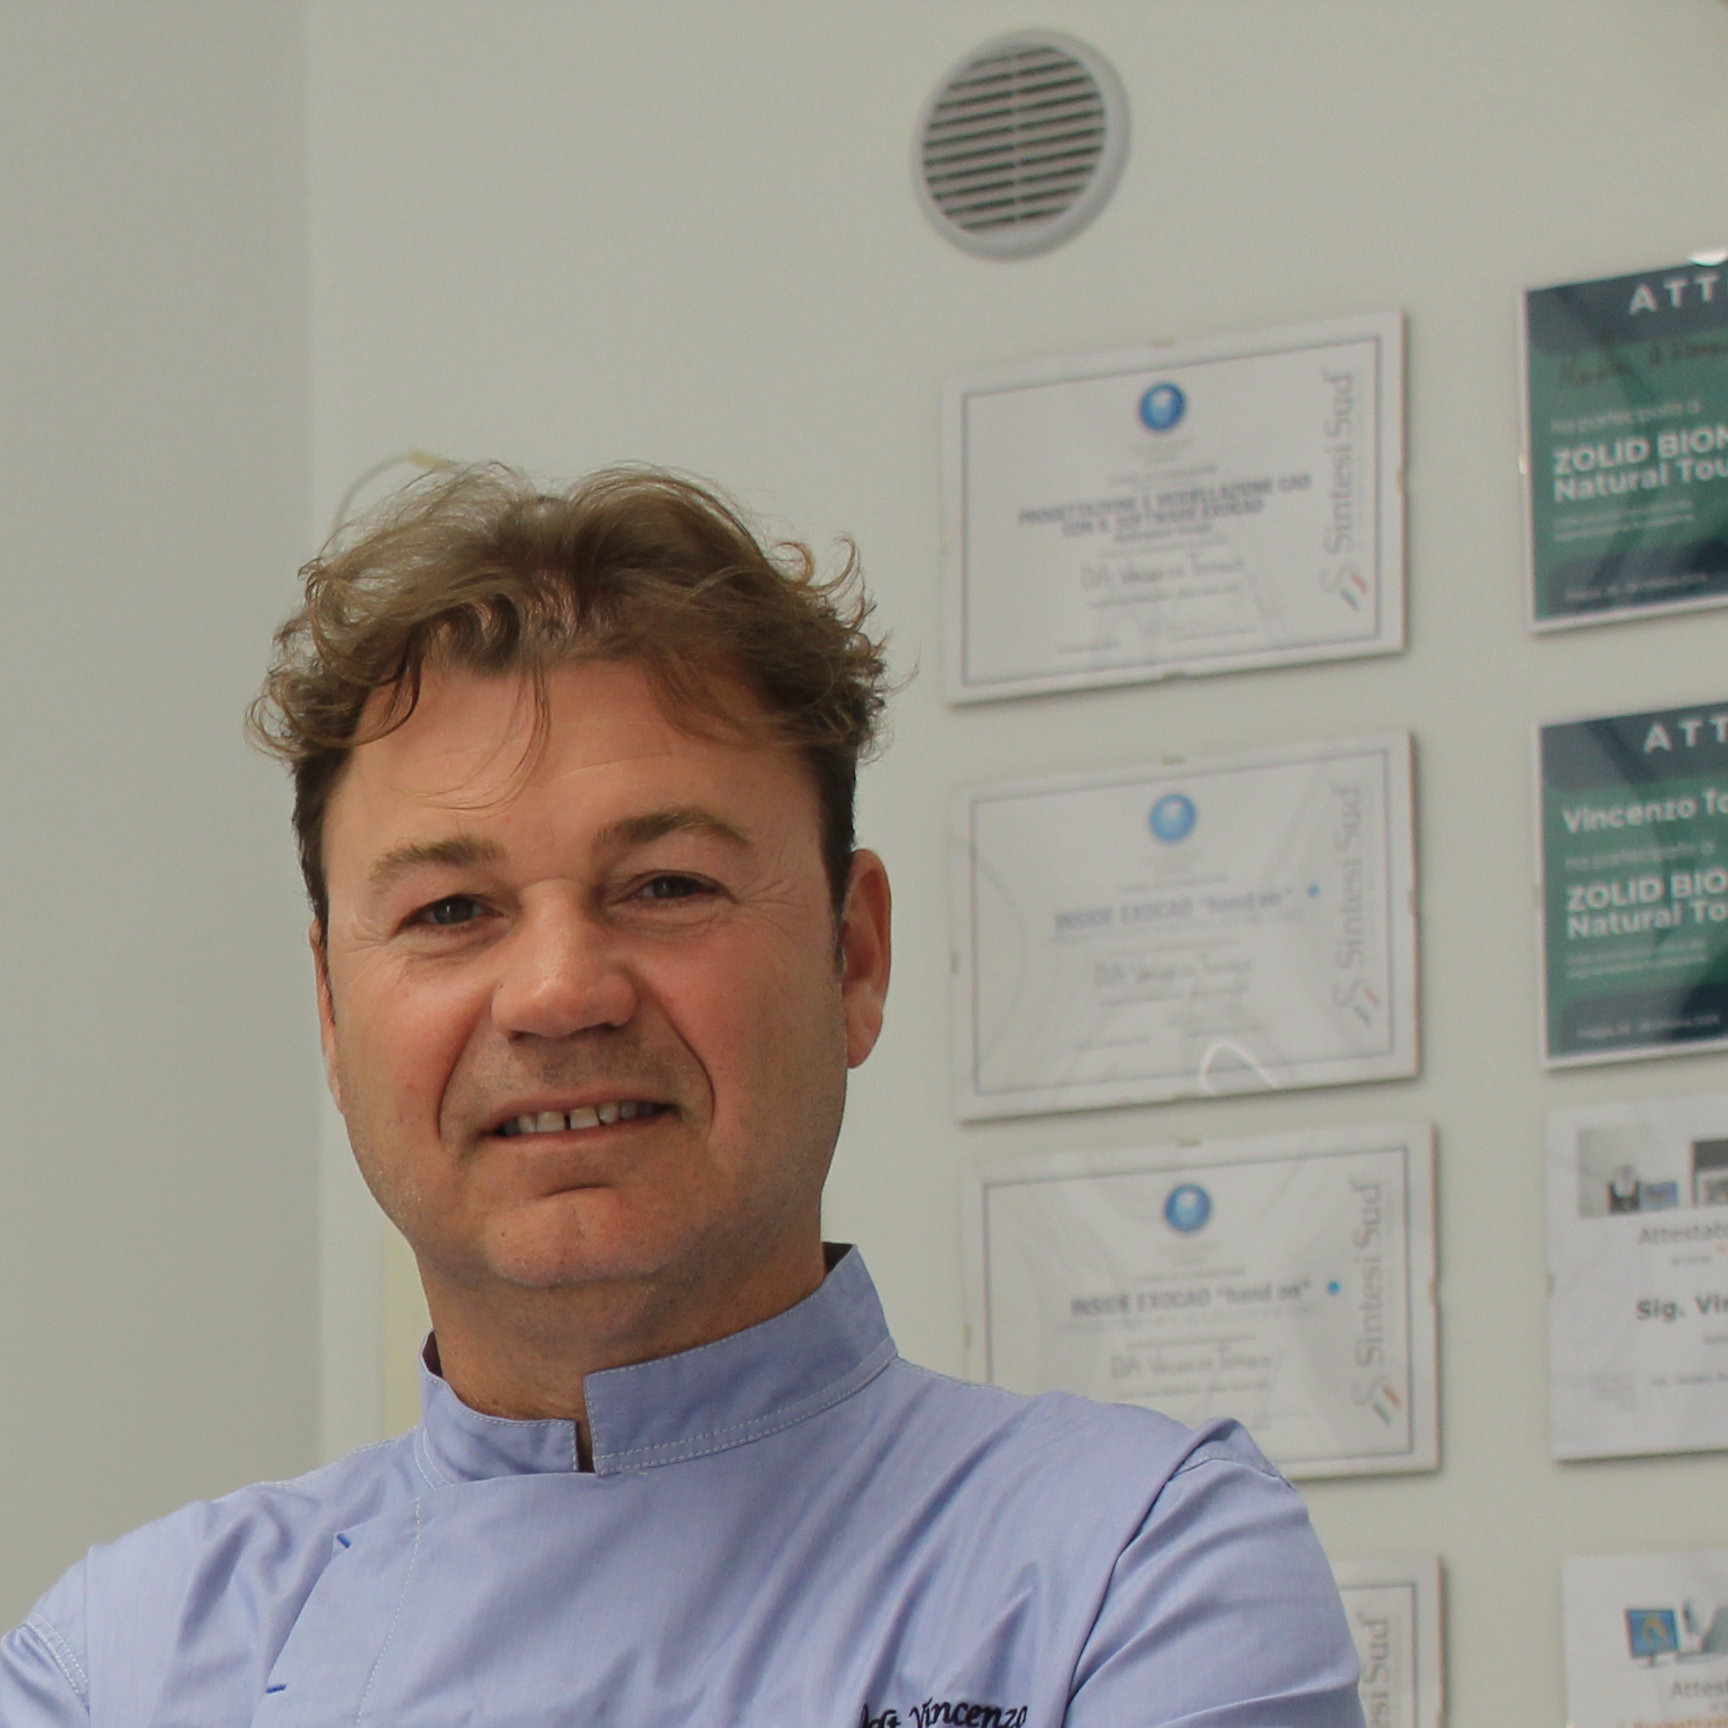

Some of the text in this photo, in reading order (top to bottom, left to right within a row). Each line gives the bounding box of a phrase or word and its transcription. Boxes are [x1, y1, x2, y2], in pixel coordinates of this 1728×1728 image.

[1552, 438, 1650, 477] ZOLID
[1553, 462, 1669, 503] Natural
[1561, 795, 1698, 834] Vincenzo
[1565, 873, 1664, 915] ZOLID
[1567, 901, 1684, 941] Natural
[1635, 1299, 1686, 1322] Sig.
